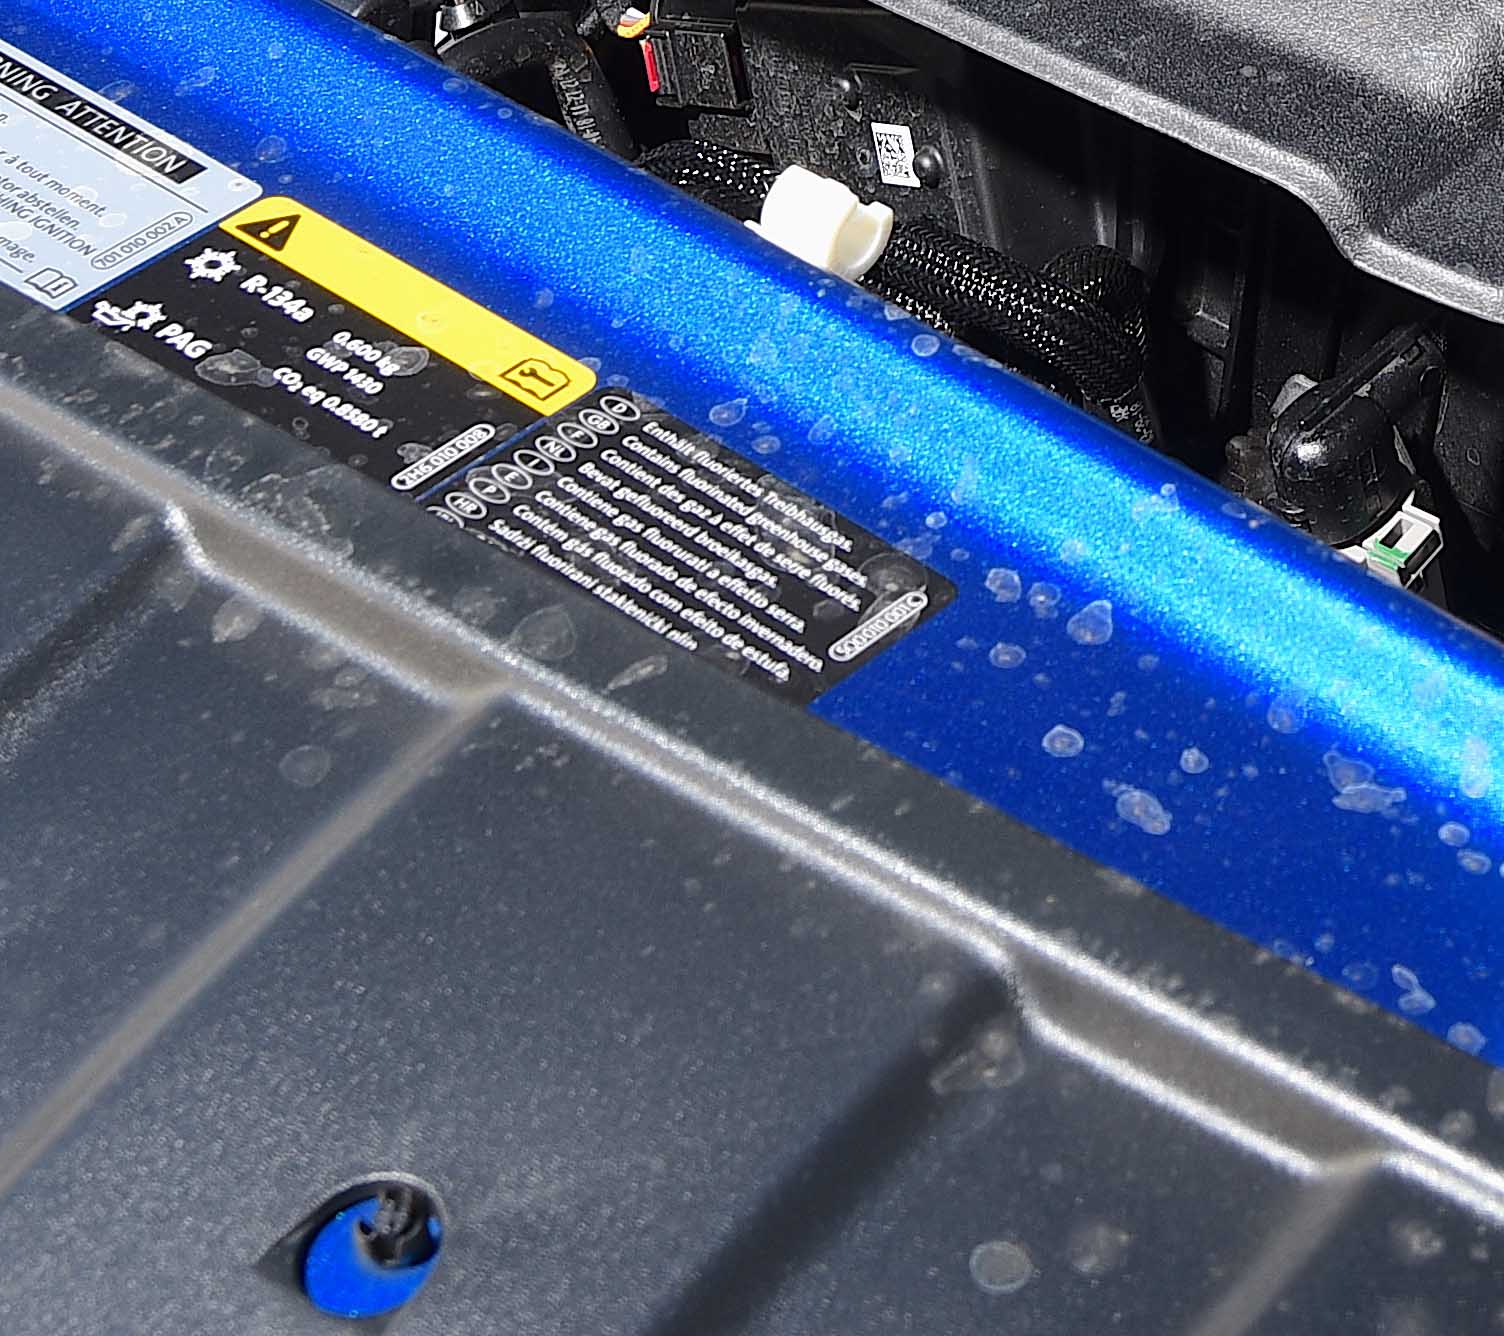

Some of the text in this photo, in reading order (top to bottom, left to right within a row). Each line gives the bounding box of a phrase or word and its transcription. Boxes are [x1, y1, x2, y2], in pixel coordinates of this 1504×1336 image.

[51, 97, 189, 174] ATTENTION
[2, 154, 22, 165] à
[13, 160, 52, 182] tout
[41, 178, 112, 218] moment.
[13, 187, 90, 231] abstellen.
[24, 214, 100, 257] IGNITION
[93, 214, 188, 267] 701 010 002 A
[235, 273, 324, 323] R-134a
[150, 321, 217, 359] PAG
[327, 329, 406, 377] 0.600 kg
[300, 345, 388, 396] GWP 1430
[293, 383, 329, 405] eq
[317, 394, 384, 432] 0.8580
[369, 424, 392, 438] t
[397, 461, 435, 485] 2H6
[427, 445, 460, 467] 010
[540, 439, 570, 457] NL
[574, 460, 626, 491] Bevat
[609, 483, 705, 538] gefluoreerd
[583, 412, 613, 430] GB
[617, 433, 687, 474] Contains
[672, 465, 760, 517] fluorinated
[742, 510, 834, 564] greenhouse
[688, 449, 770, 497] fluoriertes
[450, 496, 480, 514] HR
[550, 474, 627, 518] Contiene
[594, 446, 667, 489] Contient
[654, 480, 691, 503] des
[676, 497, 715, 521] gaz
[715, 518, 762, 546] effet
[750, 538, 781, 558] de
[768, 551, 816, 581] serre
[609, 512, 648, 535] gas
[526, 488, 606, 532] Contiene
[586, 525, 625, 549] gas
[611, 538, 688, 582] fluorado
[671, 572, 705, 594] de
[688, 585, 749, 621] efecto
[634, 525, 718, 573] fluorurati
[703, 566, 724, 580] a
[504, 502, 578, 542] Contém
[583, 549, 662, 594] fluorado
[642, 587, 688, 613] com
[673, 604, 733, 639] efeito
[717, 629, 752, 651] de
[711, 571, 777, 610] effetto
